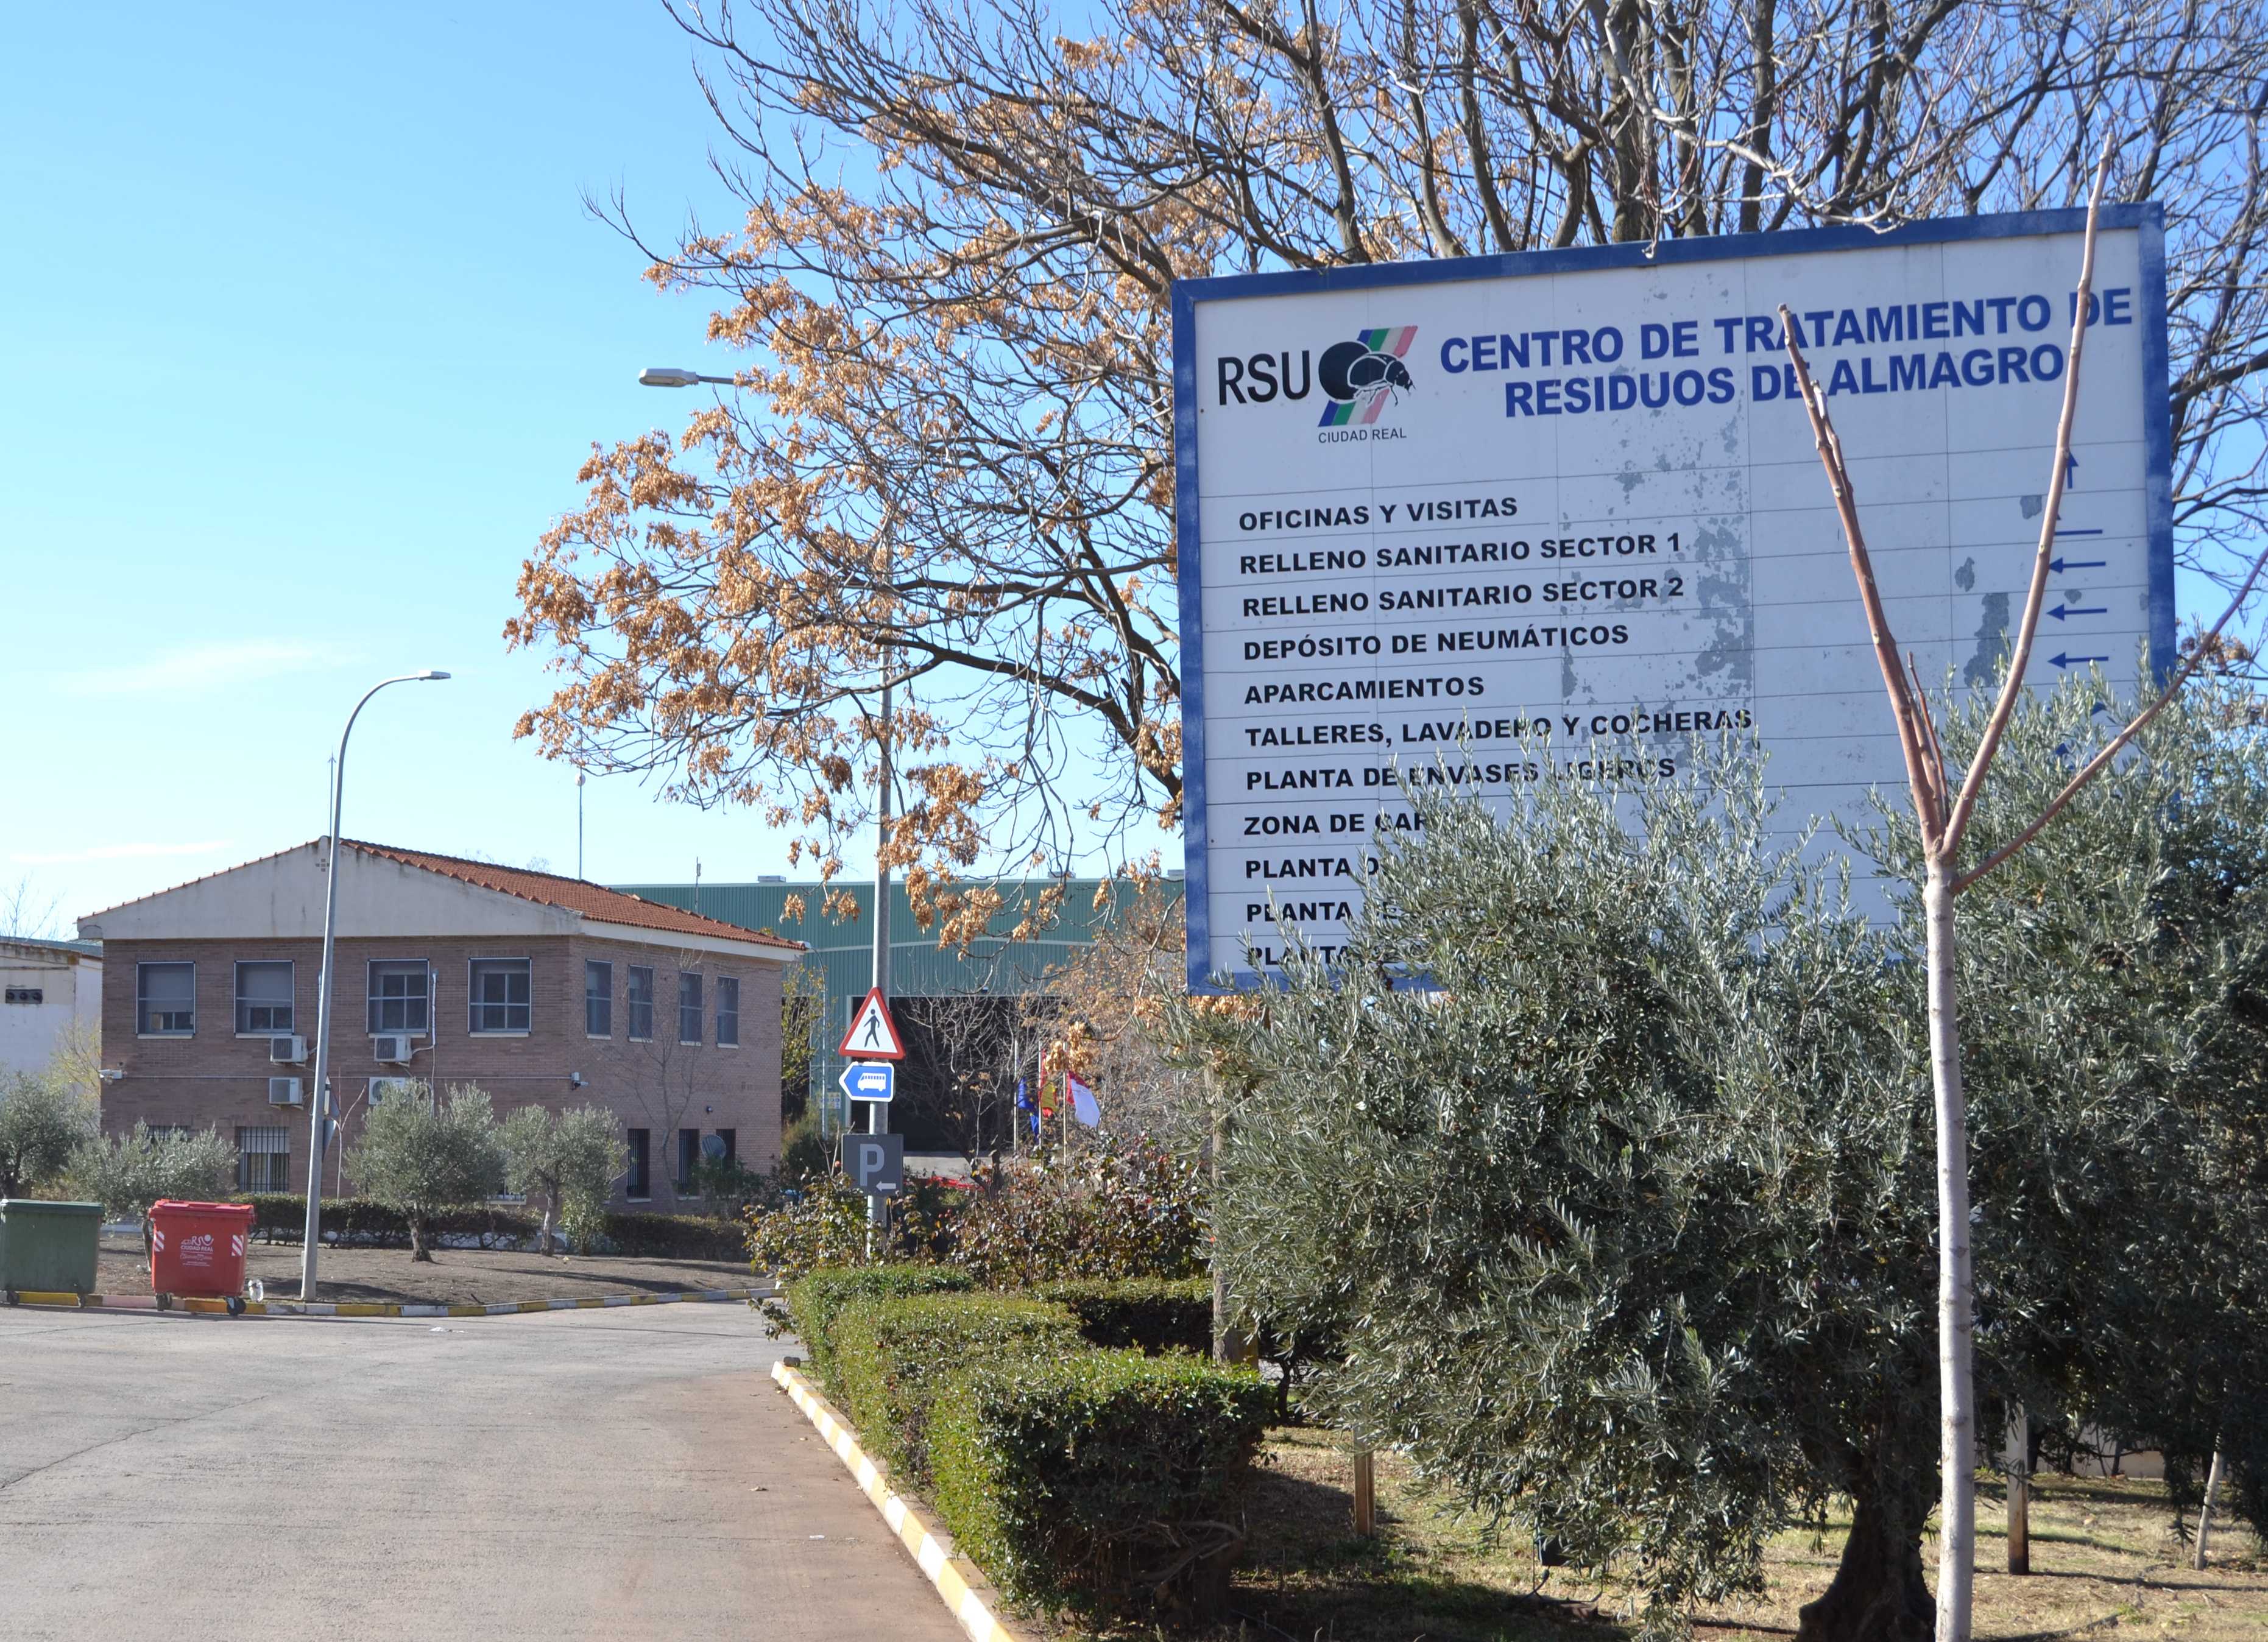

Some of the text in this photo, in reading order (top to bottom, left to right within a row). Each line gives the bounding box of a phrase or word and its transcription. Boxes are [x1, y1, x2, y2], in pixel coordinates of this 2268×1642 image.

[1441, 287, 2132, 373] CENTRO DE TRATAMIENTO DE
[1218, 350, 1310, 406] RSU
[1505, 344, 2063, 417] RESIDUOS DE ALMAGRO
[1318, 427, 1407, 443] CIUDAD REAL
[1239, 497, 1517, 530] OFICINAS Y VISITAS
[1240, 532, 1679, 574] RELLENO SANITARIO SECTOR 1
[1243, 577, 1683, 617] RELLENO SANITARIO SECTOR 2
[1244, 624, 1628, 660] DEPÓSITO DE NEUMÁTICOS
[1244, 676, 1485, 704] APARCAMIENTOS
[1245, 724, 1391, 748] TALLERES,
[1562, 717, 1580, 736] Y
[1591, 710, 1751, 735] COCHERAS
[1247, 769, 1354, 791] PLANTA
[1363, 768, 1397, 786] DE
[1244, 815, 1320, 836] ZONA
[1330, 814, 1365, 833] DE
[1246, 858, 1351, 879] PLANTA
[1247, 901, 1352, 923] PLANTA
[860, 1144, 885, 1186] P
